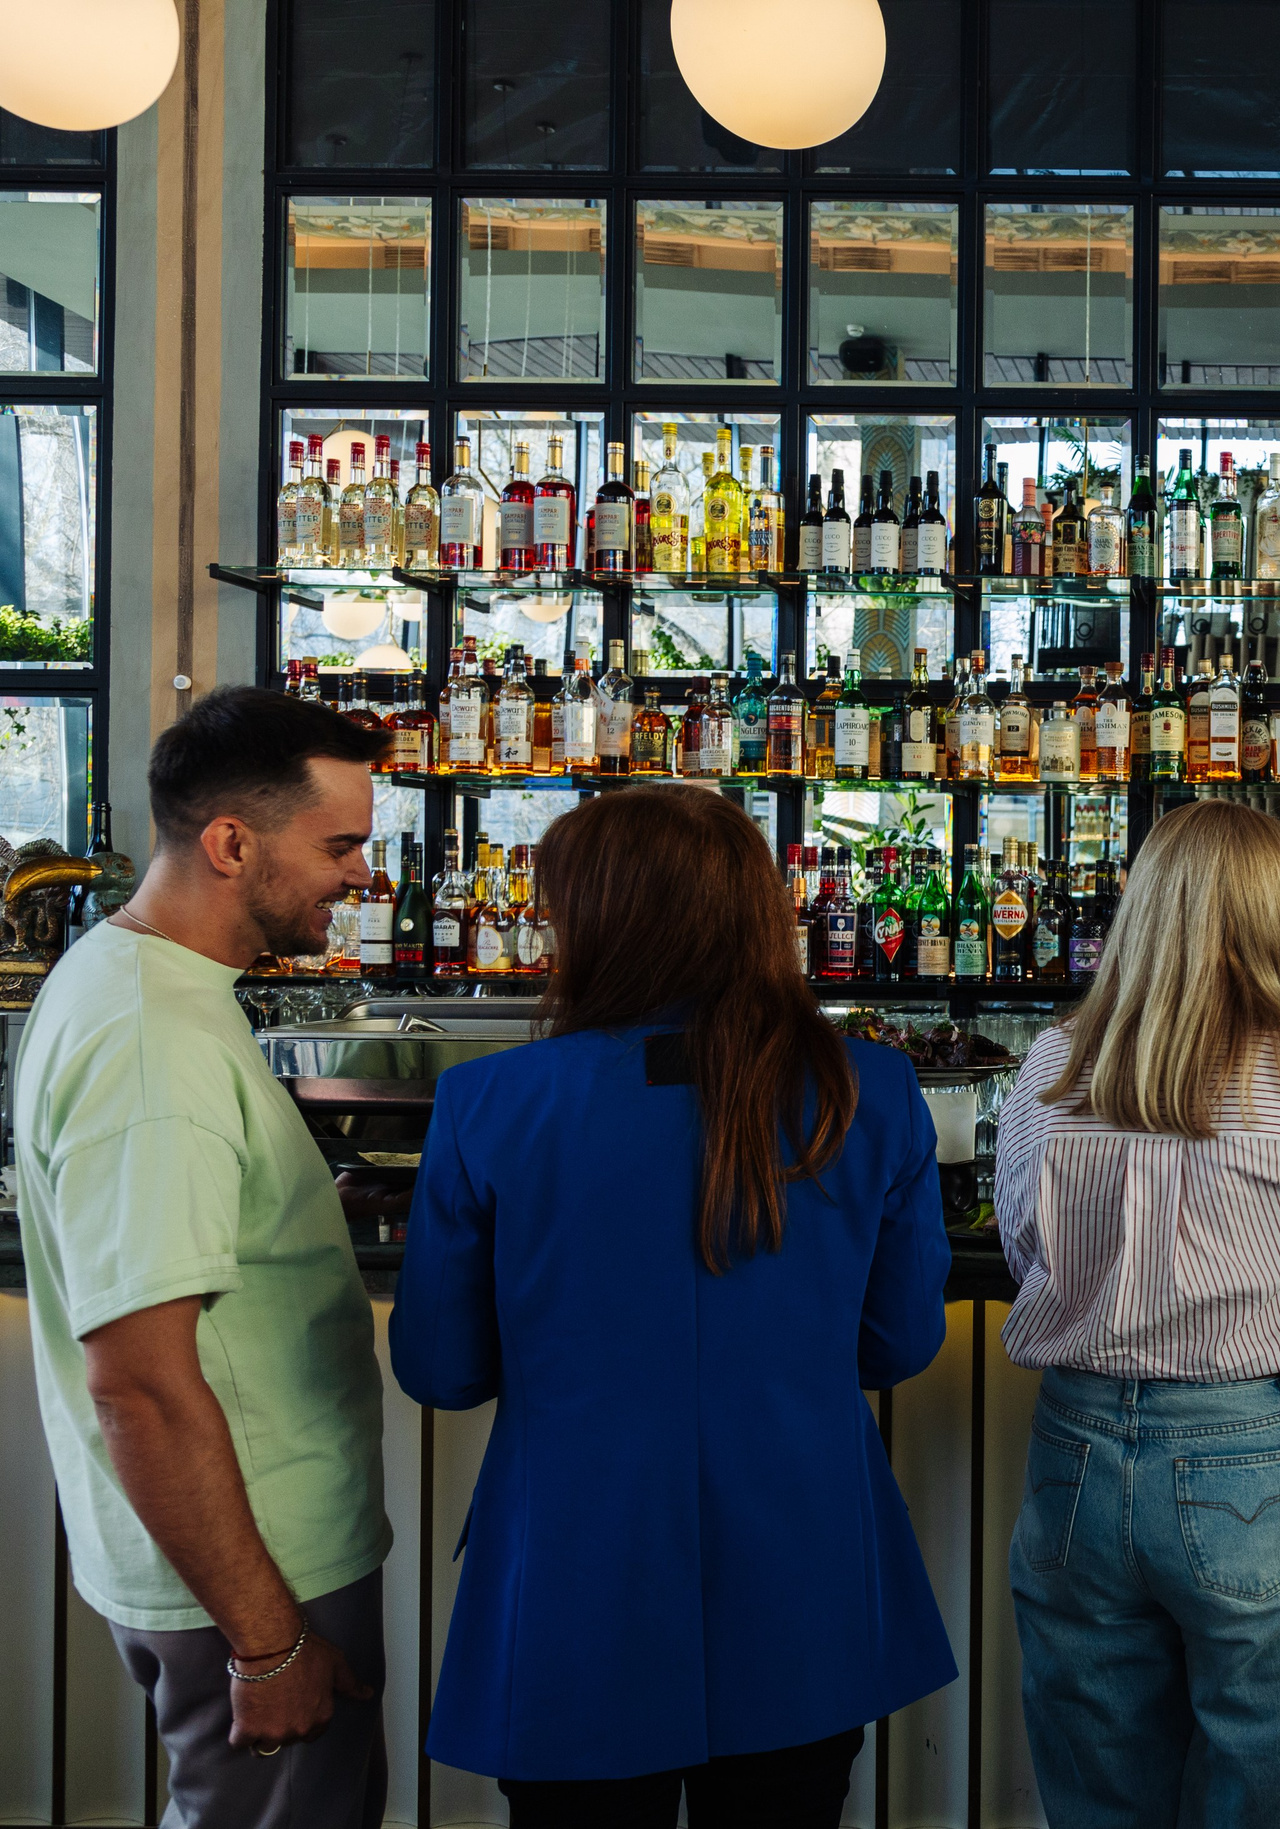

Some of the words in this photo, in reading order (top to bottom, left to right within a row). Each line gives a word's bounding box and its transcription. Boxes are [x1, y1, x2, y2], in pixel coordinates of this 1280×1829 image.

[451, 705, 480, 713] Dewar's
[769, 704, 802, 712] AUCHENTOSHAN
[1001, 710, 1028, 718] BOWMORE
[1151, 711, 1183, 721] JAMESON
[1131, 714, 1150, 724] JAME
[606, 727, 615, 735] 12
[740, 727, 767, 735] NGLETO
[632, 732, 665, 741] ERFELDY
[848, 738, 857, 747] 10
[993, 910, 1026, 919] AVERNA
[829, 932, 854, 940] SELECT
[874, 920, 905, 945] CYNAR
